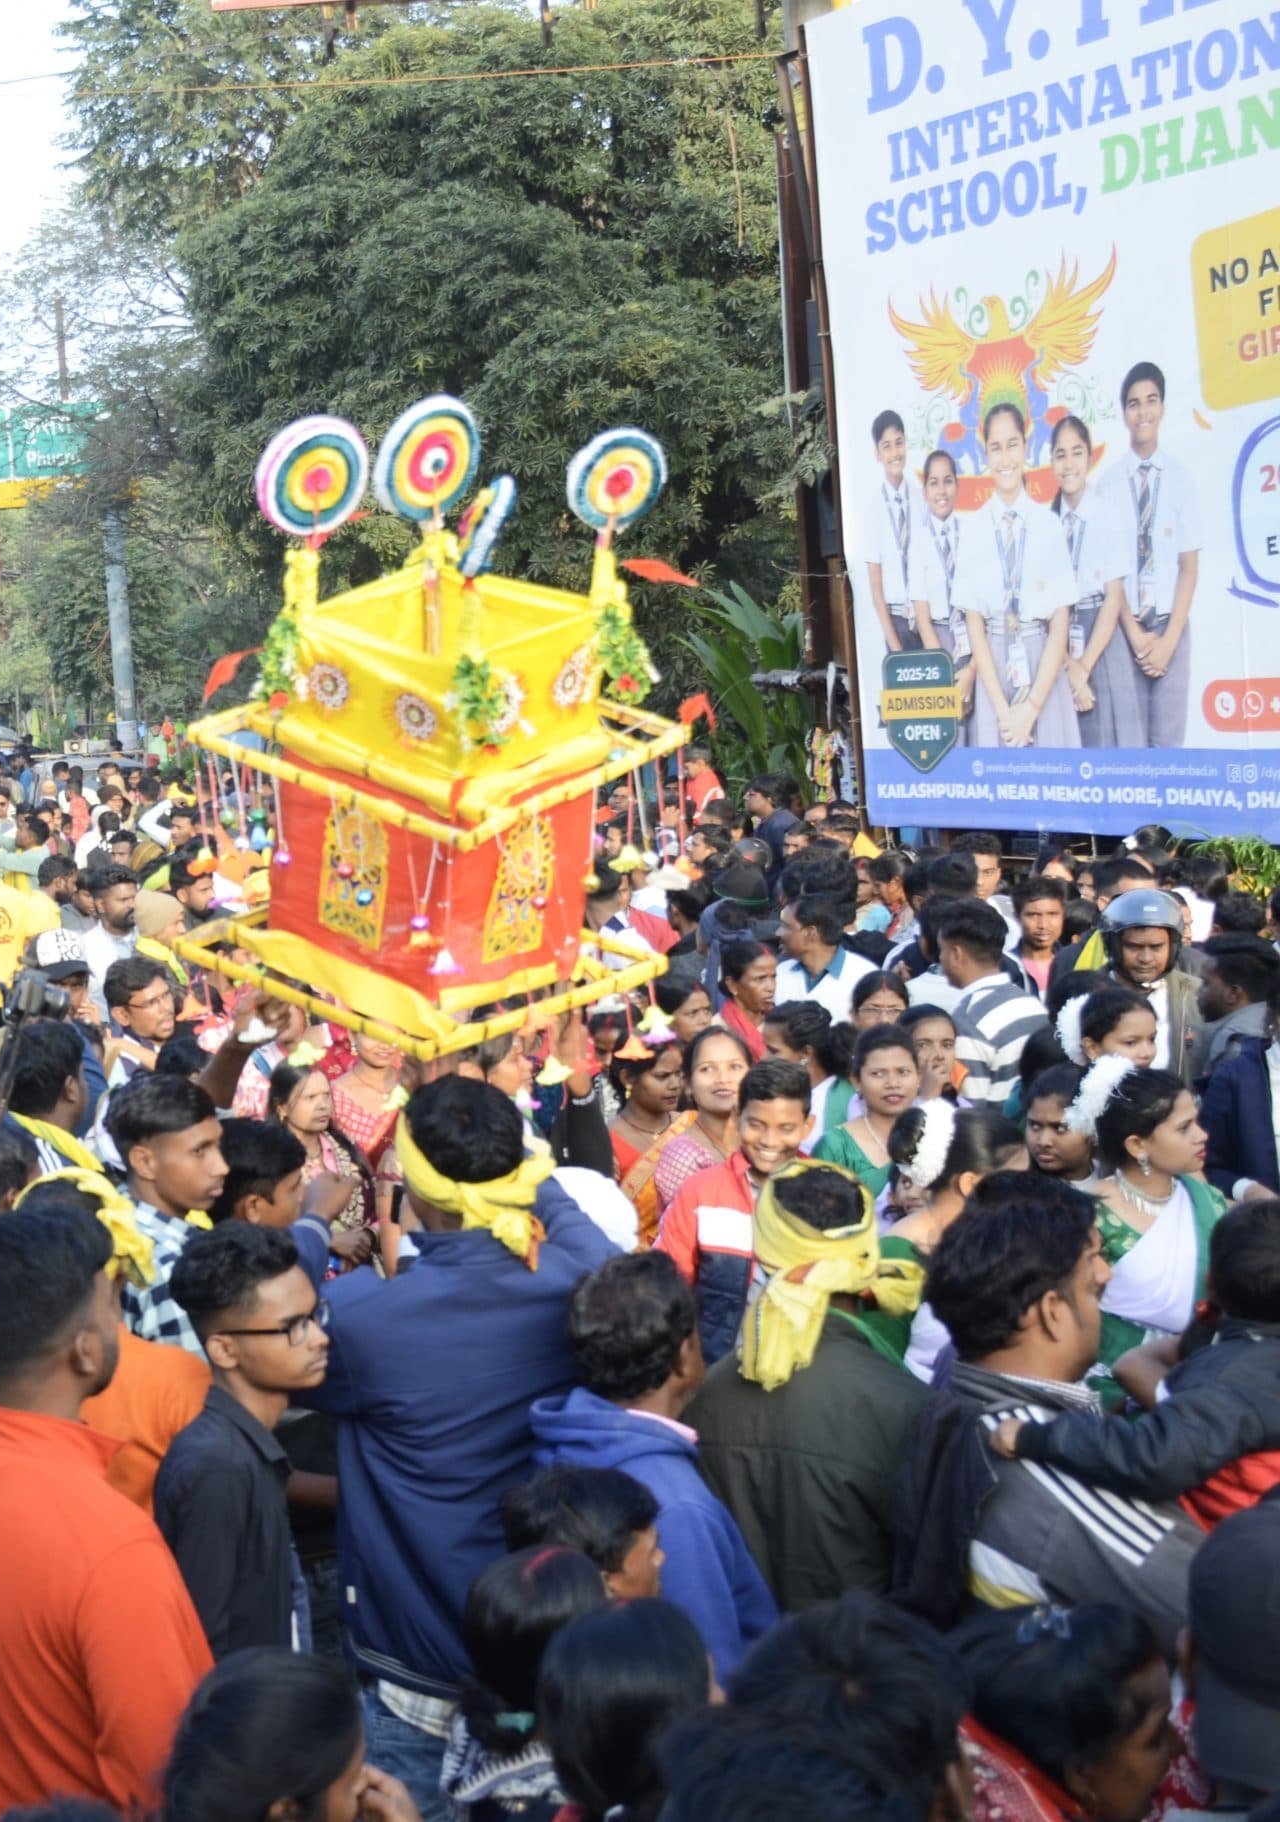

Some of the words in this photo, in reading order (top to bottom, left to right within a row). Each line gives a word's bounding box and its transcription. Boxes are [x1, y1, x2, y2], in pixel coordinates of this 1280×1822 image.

[862, 16, 945, 115] D.
[961, 0, 1050, 77] Y.
[887, 11, 1280, 182] INTERNATION
[866, 153, 1087, 254] SCHOOL,
[1099, 87, 1280, 194] DHAN
[1210, 257, 1249, 293] NO
[1259, 284, 1280, 316] F
[896, 666, 940, 682] 2025-26
[887, 695, 956, 712] ADMISSION
[904, 724, 941, 741] OPEN
[877, 783, 994, 802] KAILASHPURAM,
[996, 784, 1039, 801] NEAR
[1042, 785, 1104, 804] MEMCO
[1107, 786, 1163, 807] MORE,
[1166, 787, 1243, 811] DHAIYA,
